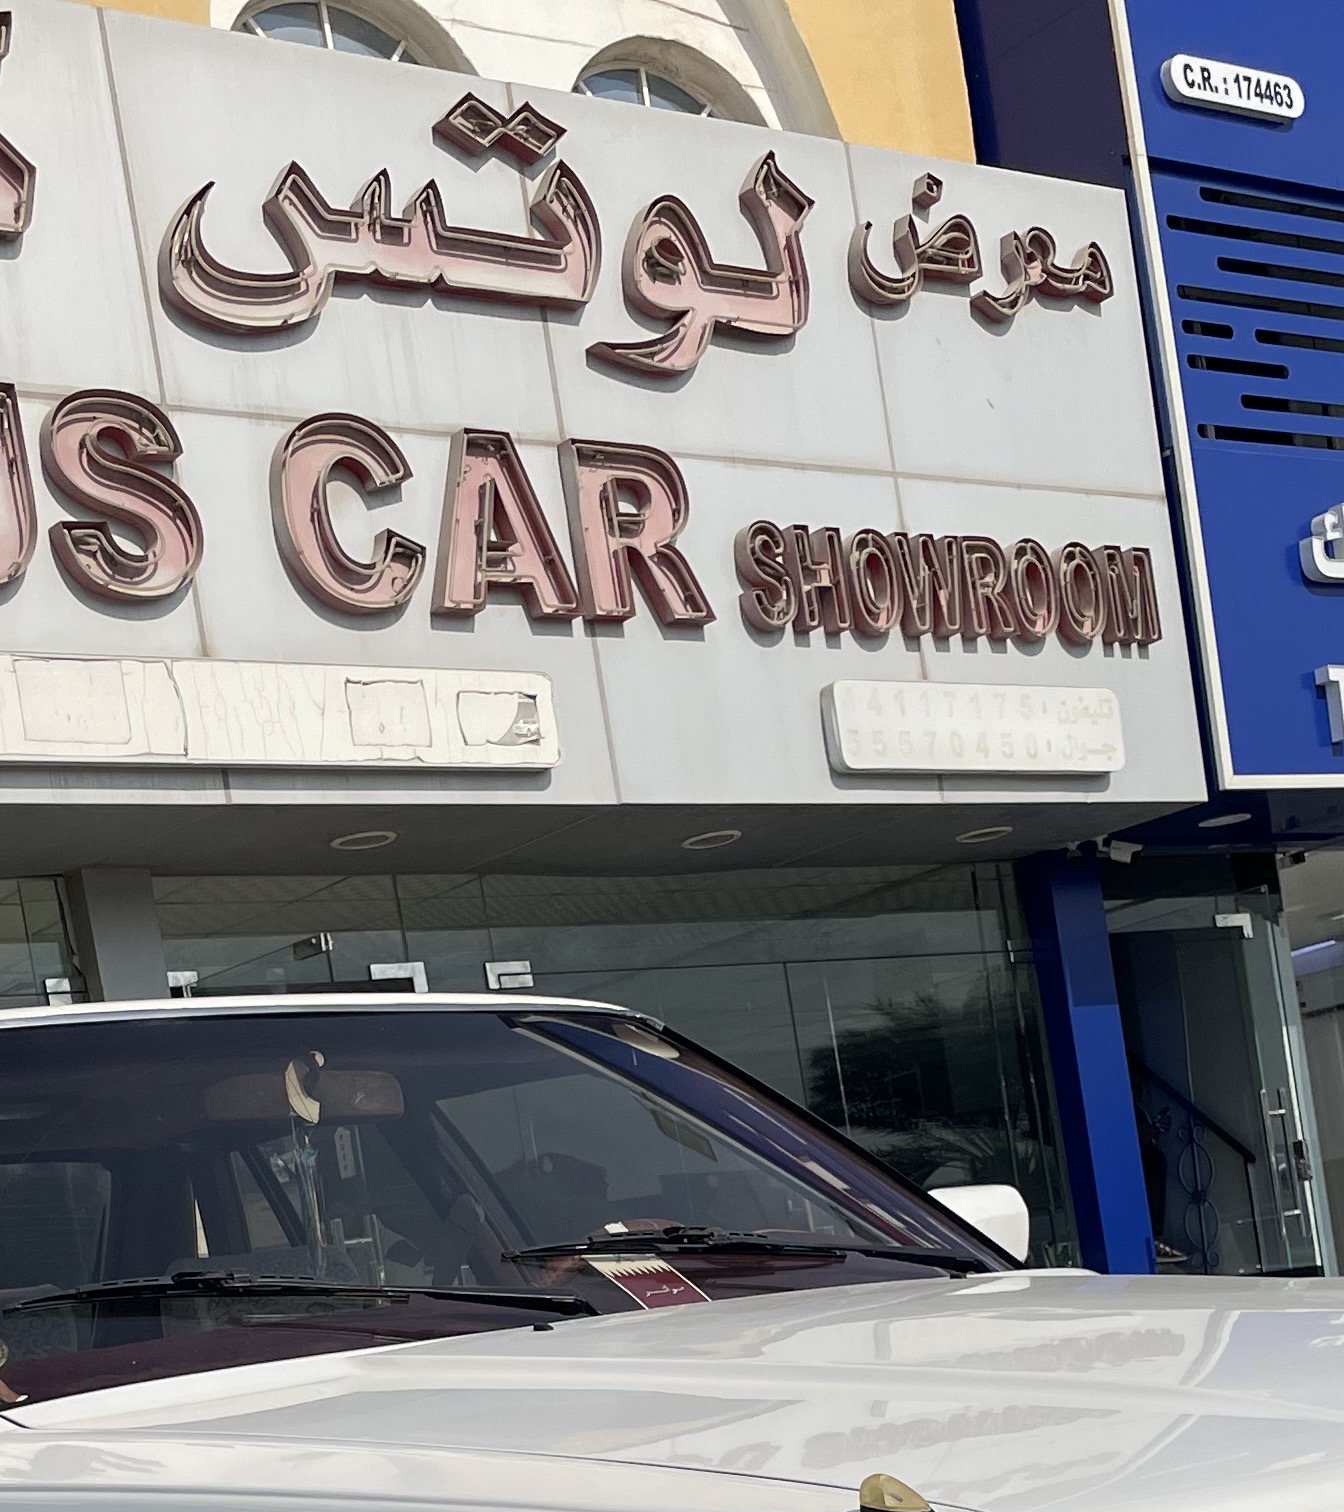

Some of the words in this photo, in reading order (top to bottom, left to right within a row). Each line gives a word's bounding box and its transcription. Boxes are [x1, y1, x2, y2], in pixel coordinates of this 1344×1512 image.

[1233, 73, 1294, 110] 174463
[158, 91, 816, 378] لوتس
[847, 172, 1114, 322] معرض
[270, 411, 716, 627] CAR
[734, 519, 1162, 646] SHOWROOM
